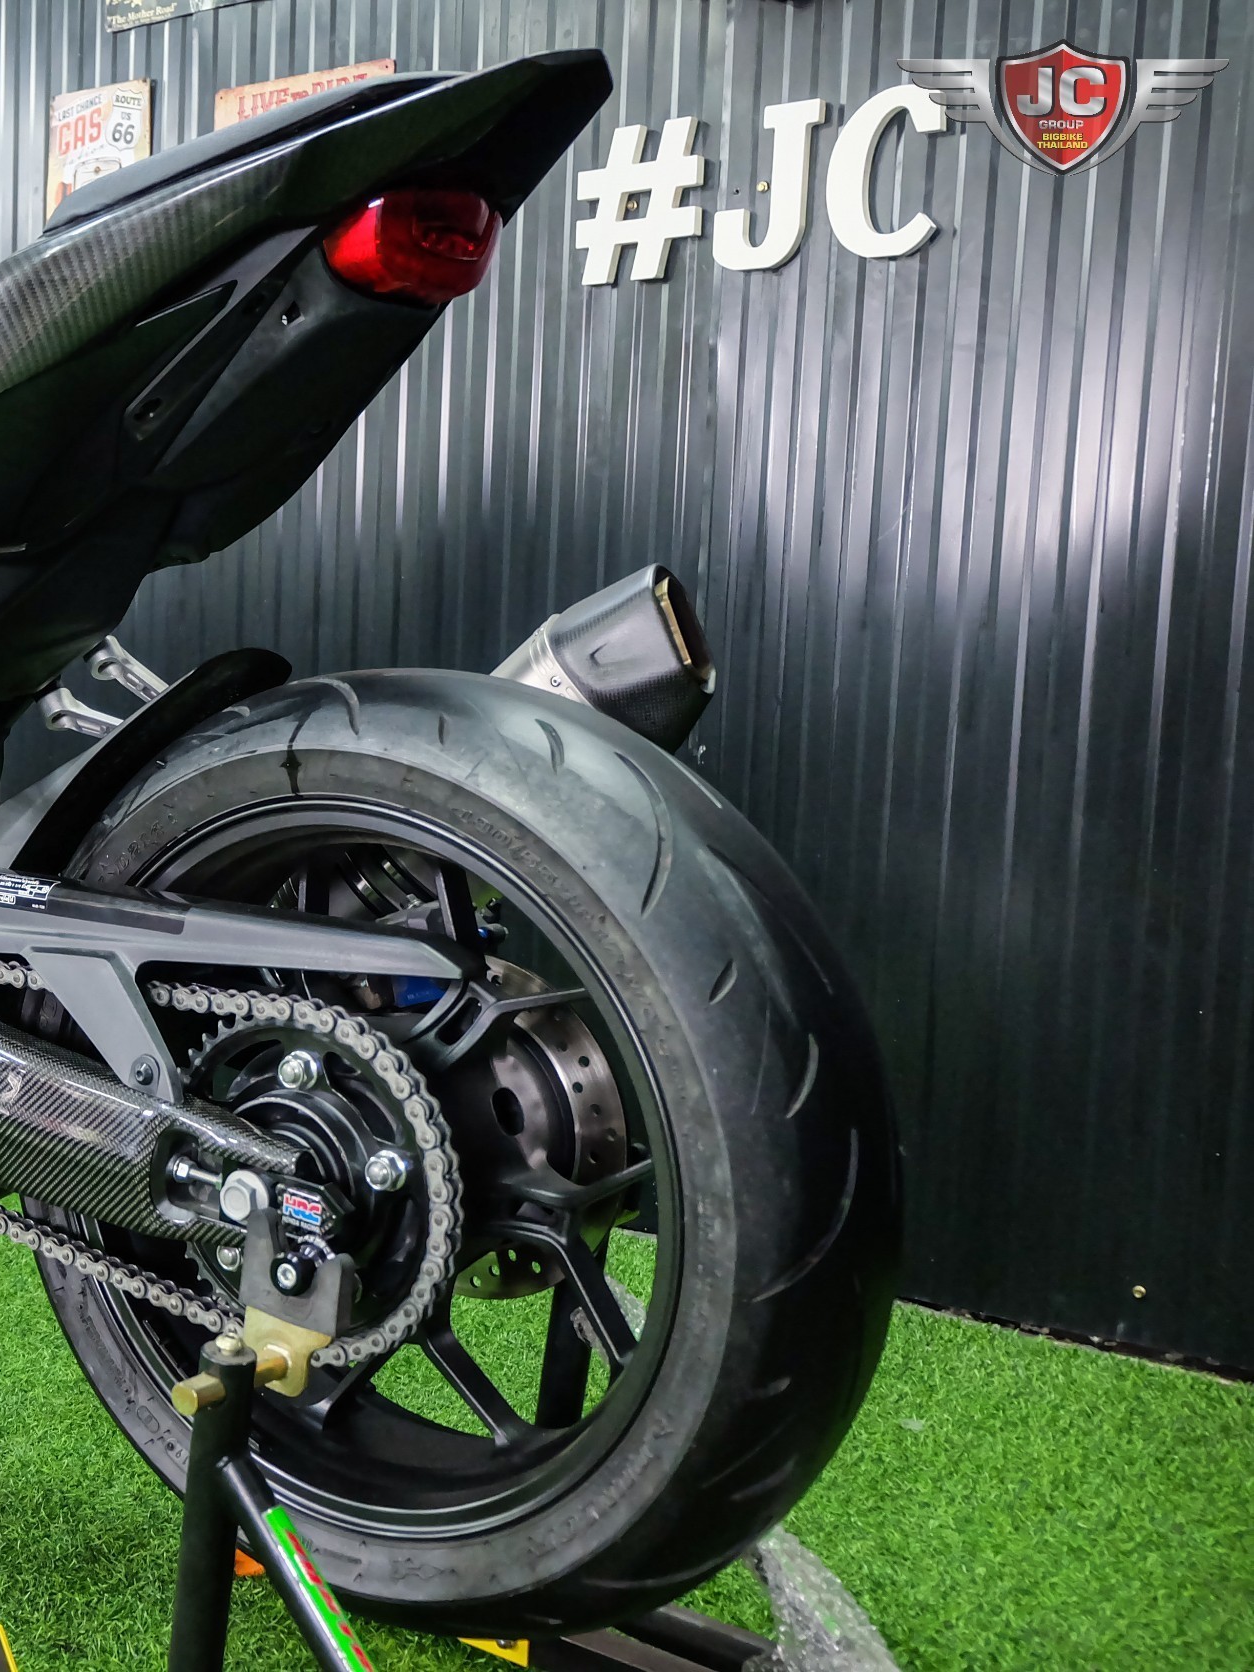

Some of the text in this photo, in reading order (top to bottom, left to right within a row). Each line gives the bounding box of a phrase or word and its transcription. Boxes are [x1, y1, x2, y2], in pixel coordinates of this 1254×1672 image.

[128, 9, 155, 20] Mother
[57, 94, 102, 121] LAST CHANCE
[115, 94, 142, 107] ROUTE
[237, 87, 290, 122] LIVE
[121, 111, 131, 120] US
[58, 106, 102, 157] GAS
[112, 122, 135, 145] 66
[575, 84, 946, 287] #JC
[283, 1193, 322, 1225] HRC
